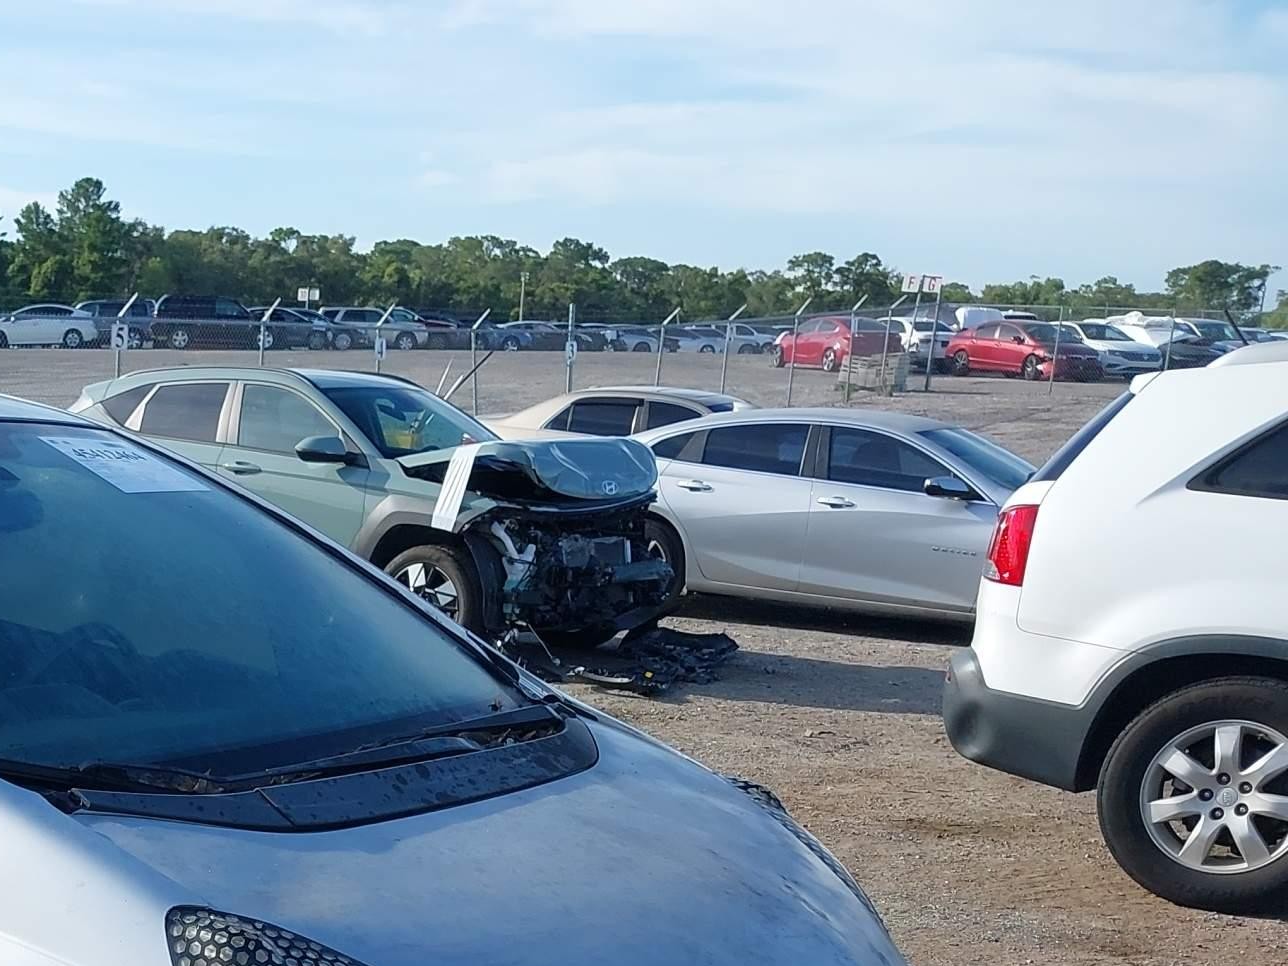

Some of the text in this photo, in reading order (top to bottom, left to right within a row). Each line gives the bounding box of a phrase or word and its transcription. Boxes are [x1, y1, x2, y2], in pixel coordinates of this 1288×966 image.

[907, 275, 916, 289] F
[927, 276, 937, 291] G
[115, 326, 125, 348] 5
[71, 447, 146, 461] 45412464
